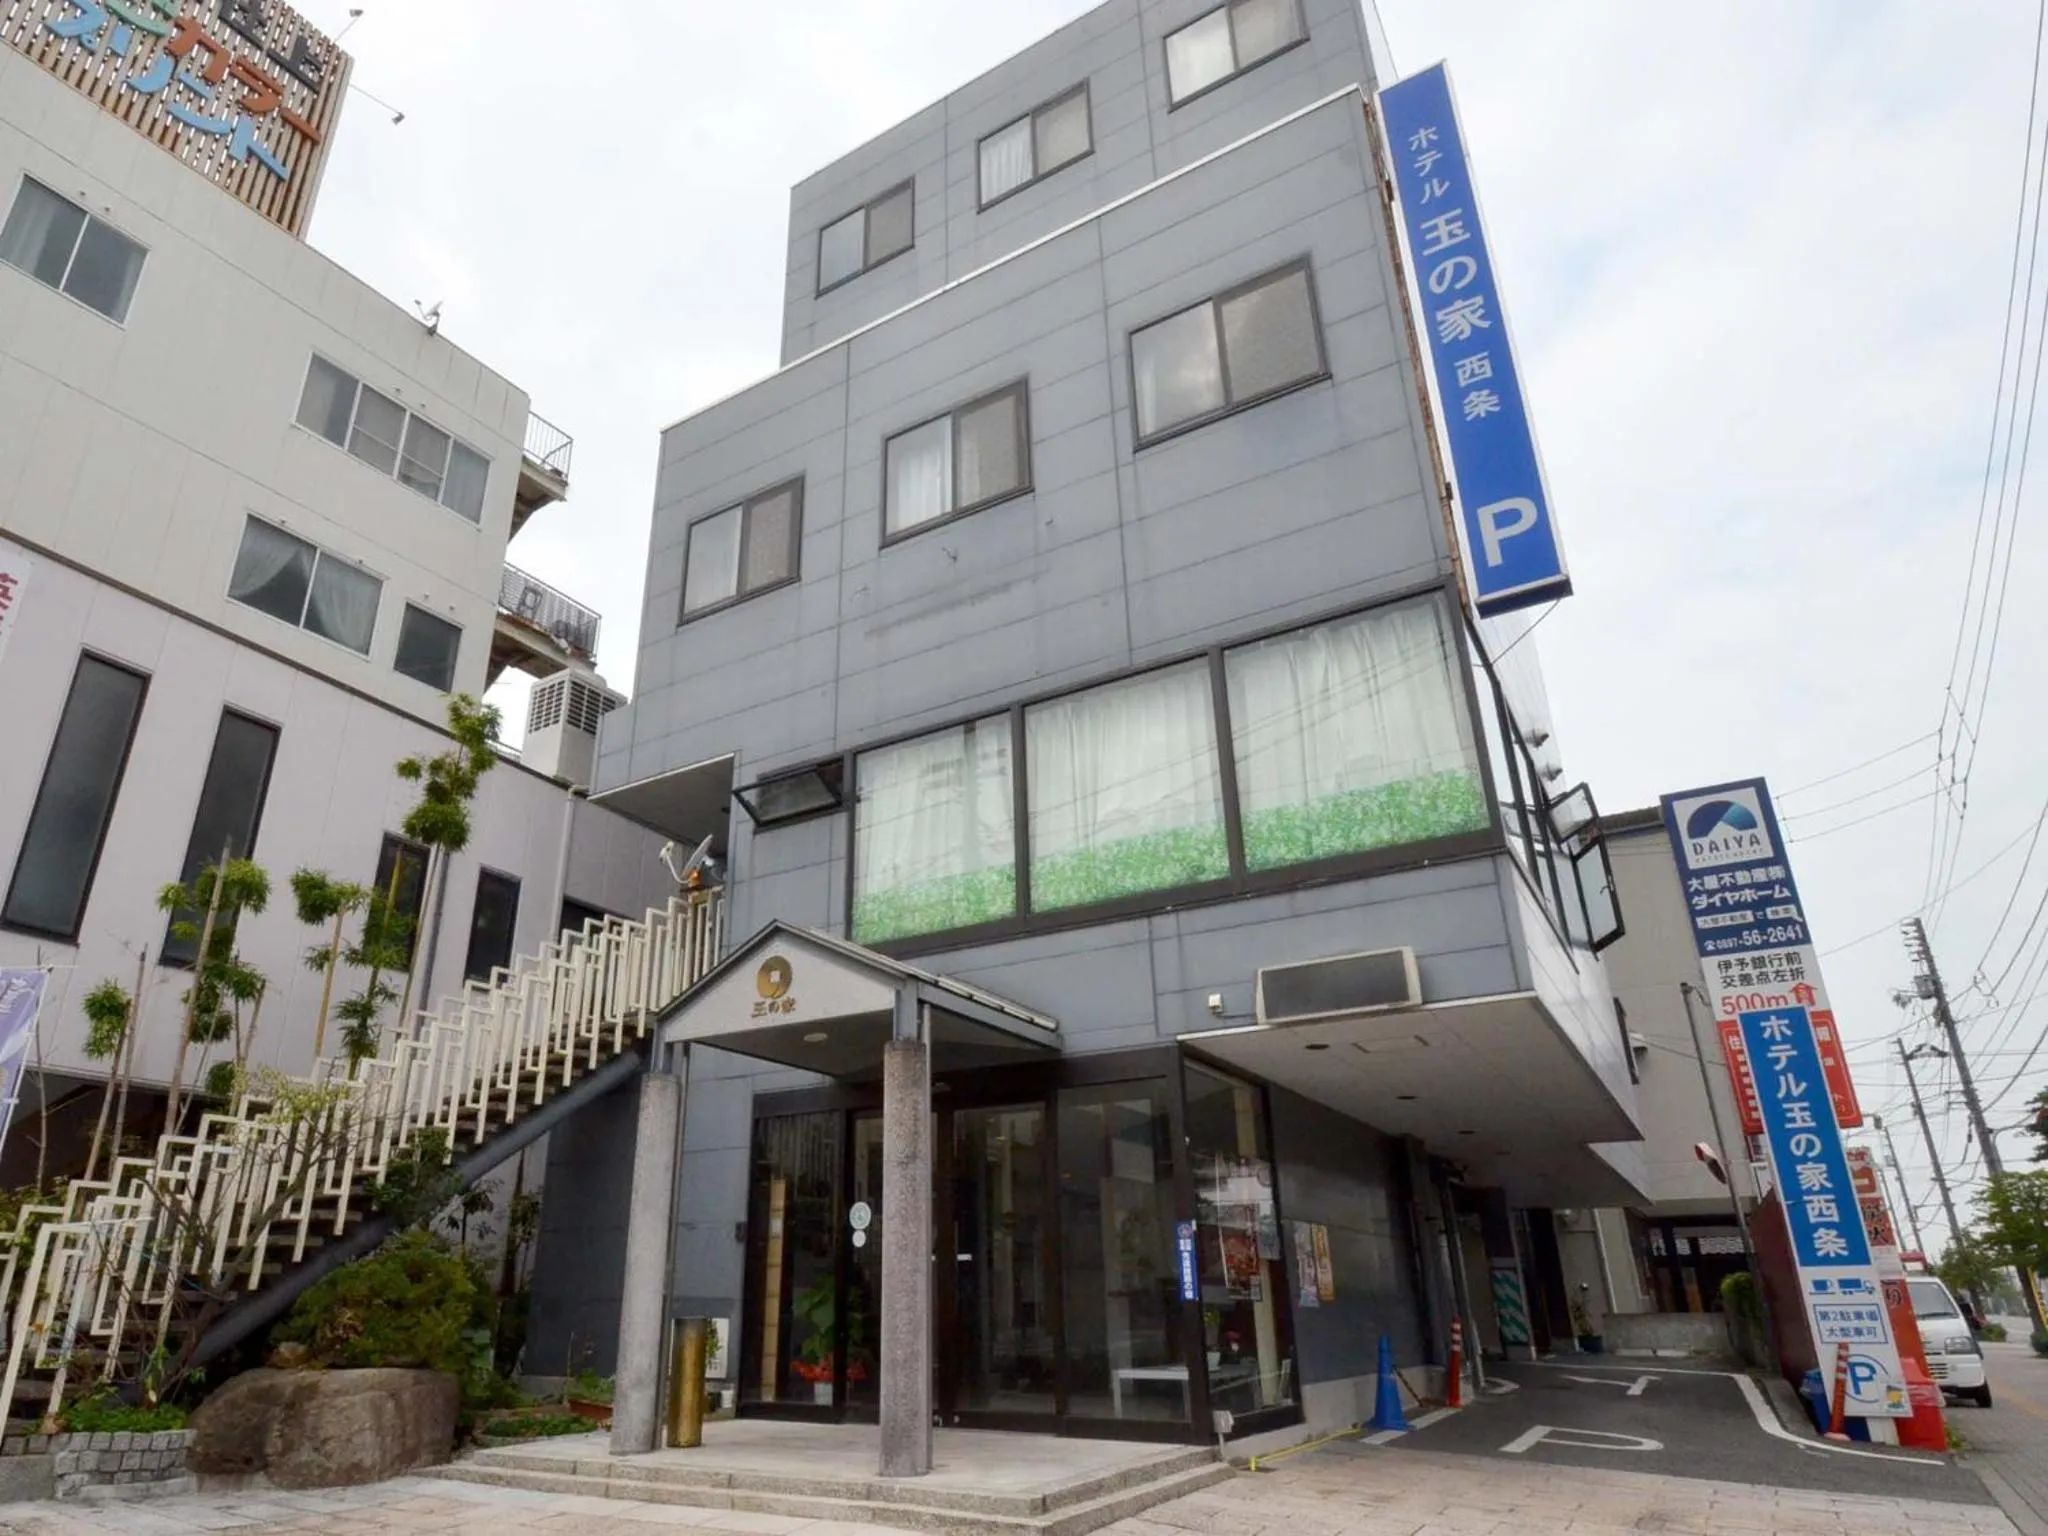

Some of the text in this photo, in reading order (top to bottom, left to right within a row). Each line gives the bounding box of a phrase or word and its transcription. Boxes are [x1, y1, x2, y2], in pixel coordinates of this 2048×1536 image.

[1477, 496, 1538, 568] P
[1693, 834, 1762, 856] DAIYA
[1692, 884, 1791, 909] ダイヤホーム
[1718, 952, 1802, 974] 伊予銀行前
[1720, 967, 1805, 989] 交差点左折
[1722, 992, 1788, 1015] 500m
[1760, 1016, 1849, 1257] ホテル玉の家西条
[1826, 1326, 1877, 1339] 大型車可
[1847, 1361, 1877, 1395] P
